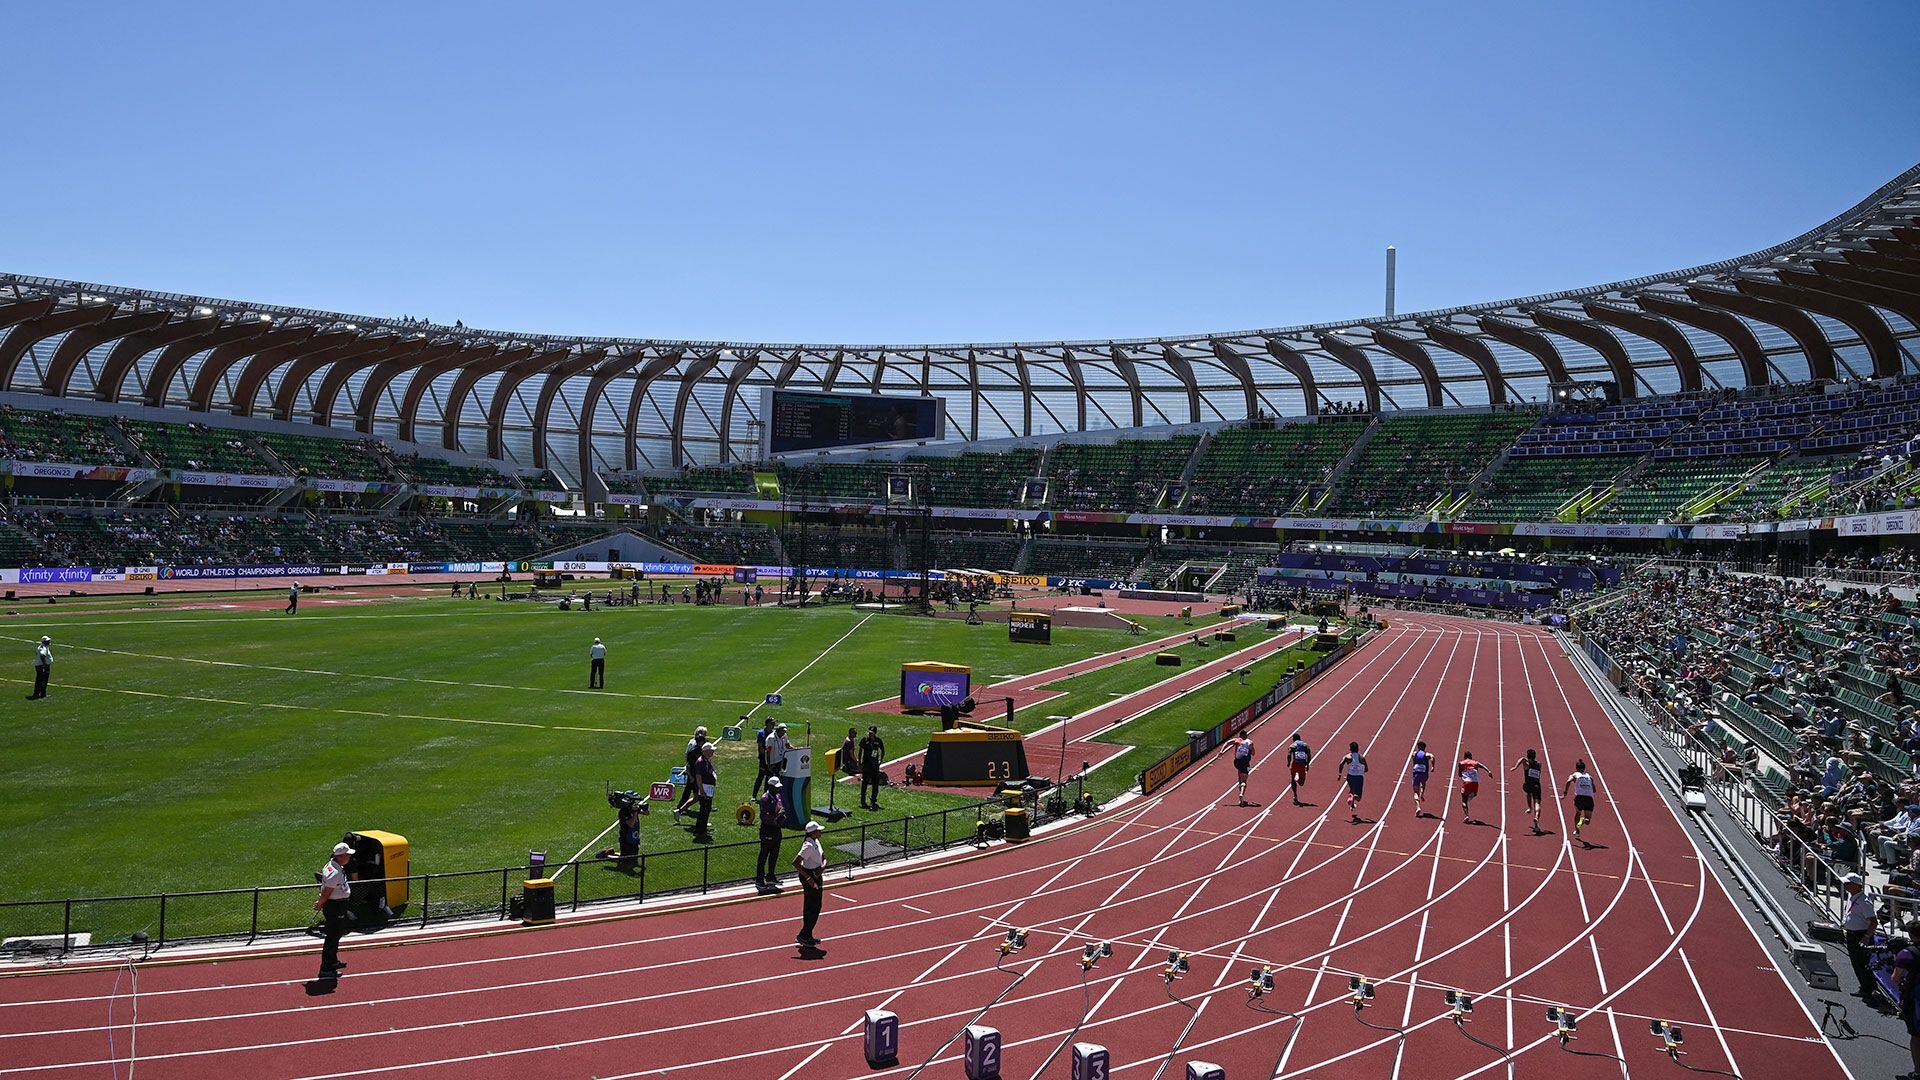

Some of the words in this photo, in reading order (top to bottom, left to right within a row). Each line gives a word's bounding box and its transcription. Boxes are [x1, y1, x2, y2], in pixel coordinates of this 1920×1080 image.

[33, 468, 71, 477] OREGON22
[454, 562, 480, 572] MONDO
[570, 562, 587, 570] QNB
[645, 564, 666, 573] xfinity
[669, 564, 691, 573] xfinity
[22, 568, 54, 582] xfinity
[59, 568, 90, 581] xfinity
[129, 573, 153, 581] SEIKO
[175, 569, 200, 577] WORLD
[202, 568, 235, 576] ATHLETICS
[238, 567, 285, 576] CHAMPIONSHIPS
[861, 570, 880, 578] TDK
[1002, 576, 1040, 586] SEIKO
[987, 732, 1015, 740] SEIKO
[653, 786, 670, 797] WR
[881, 1025, 891, 1047] 1
[983, 1042, 996, 1066] 2
[1092, 1059, 1105, 1080] 3
